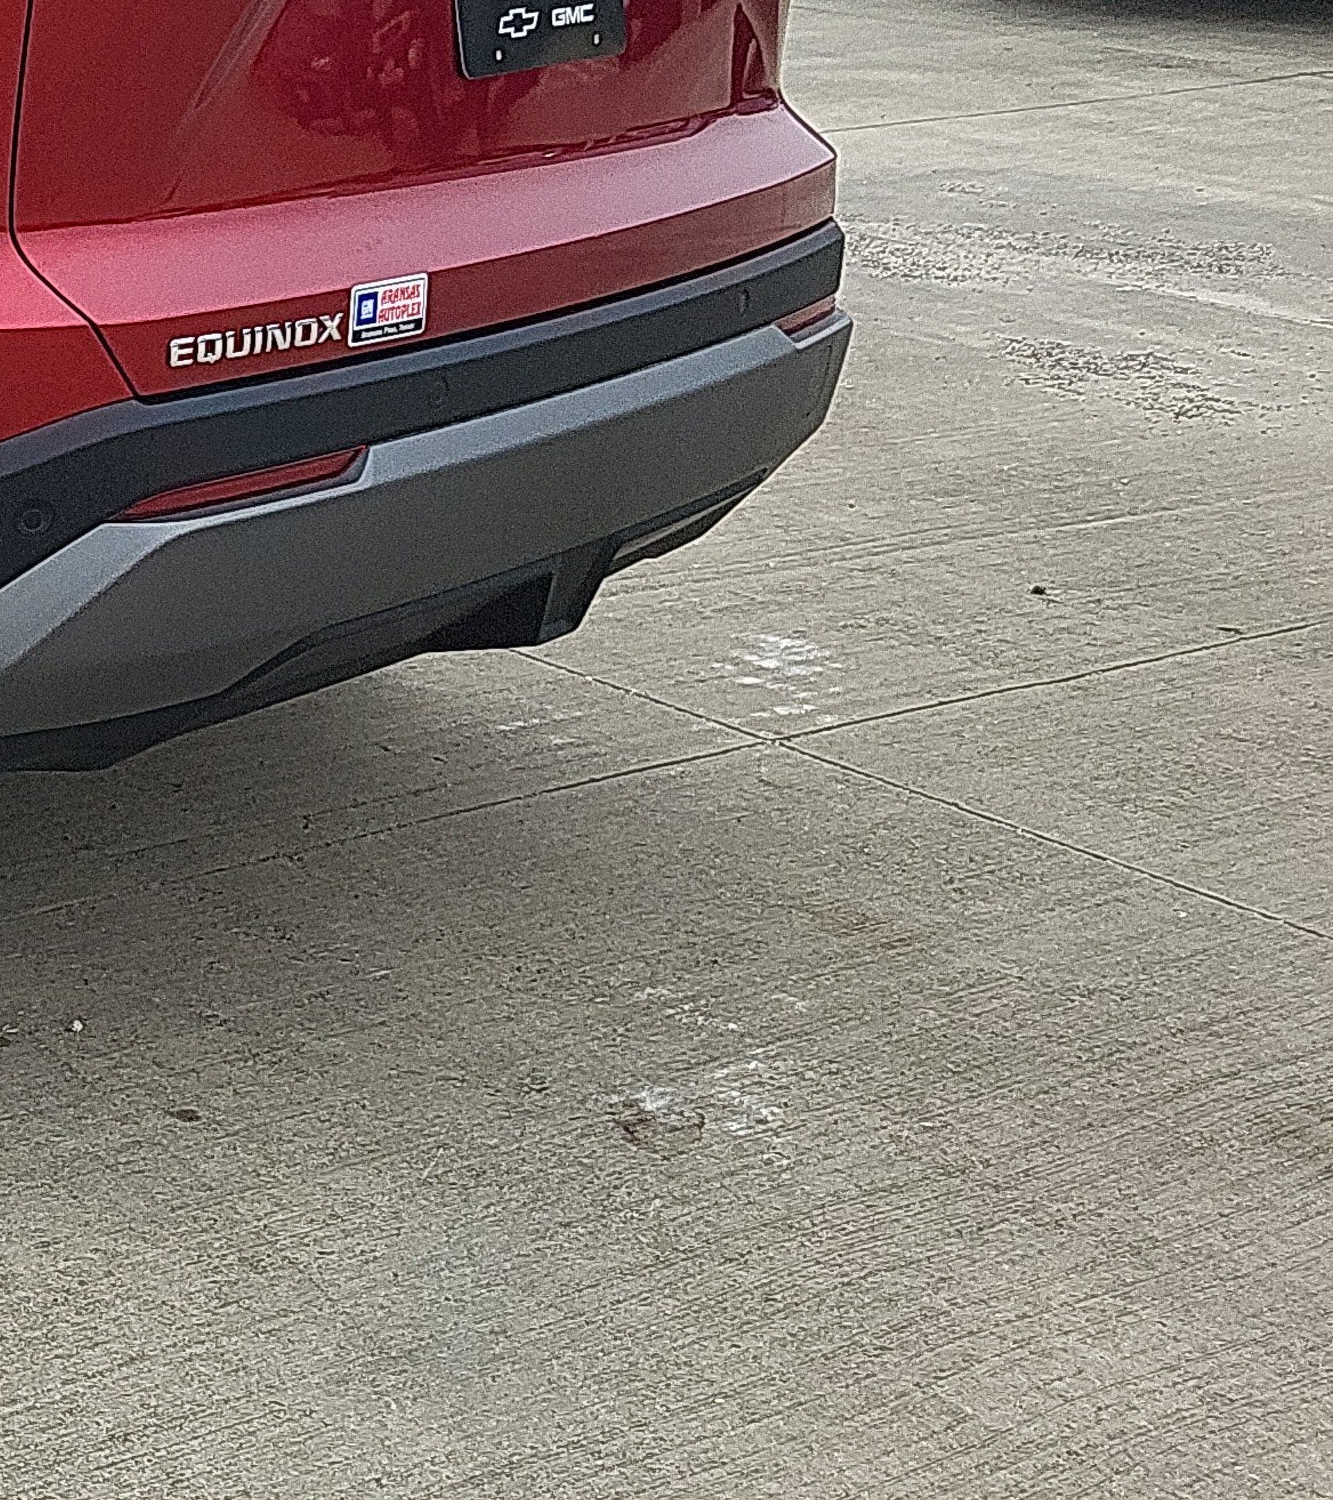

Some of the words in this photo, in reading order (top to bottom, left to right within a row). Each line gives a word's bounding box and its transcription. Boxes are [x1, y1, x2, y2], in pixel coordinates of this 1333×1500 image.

[551, 3, 595, 27] GMC
[381, 284, 422, 306] ARANSAS
[378, 301, 422, 324] AUTOPLEX
[169, 312, 344, 367] EQUINOX
